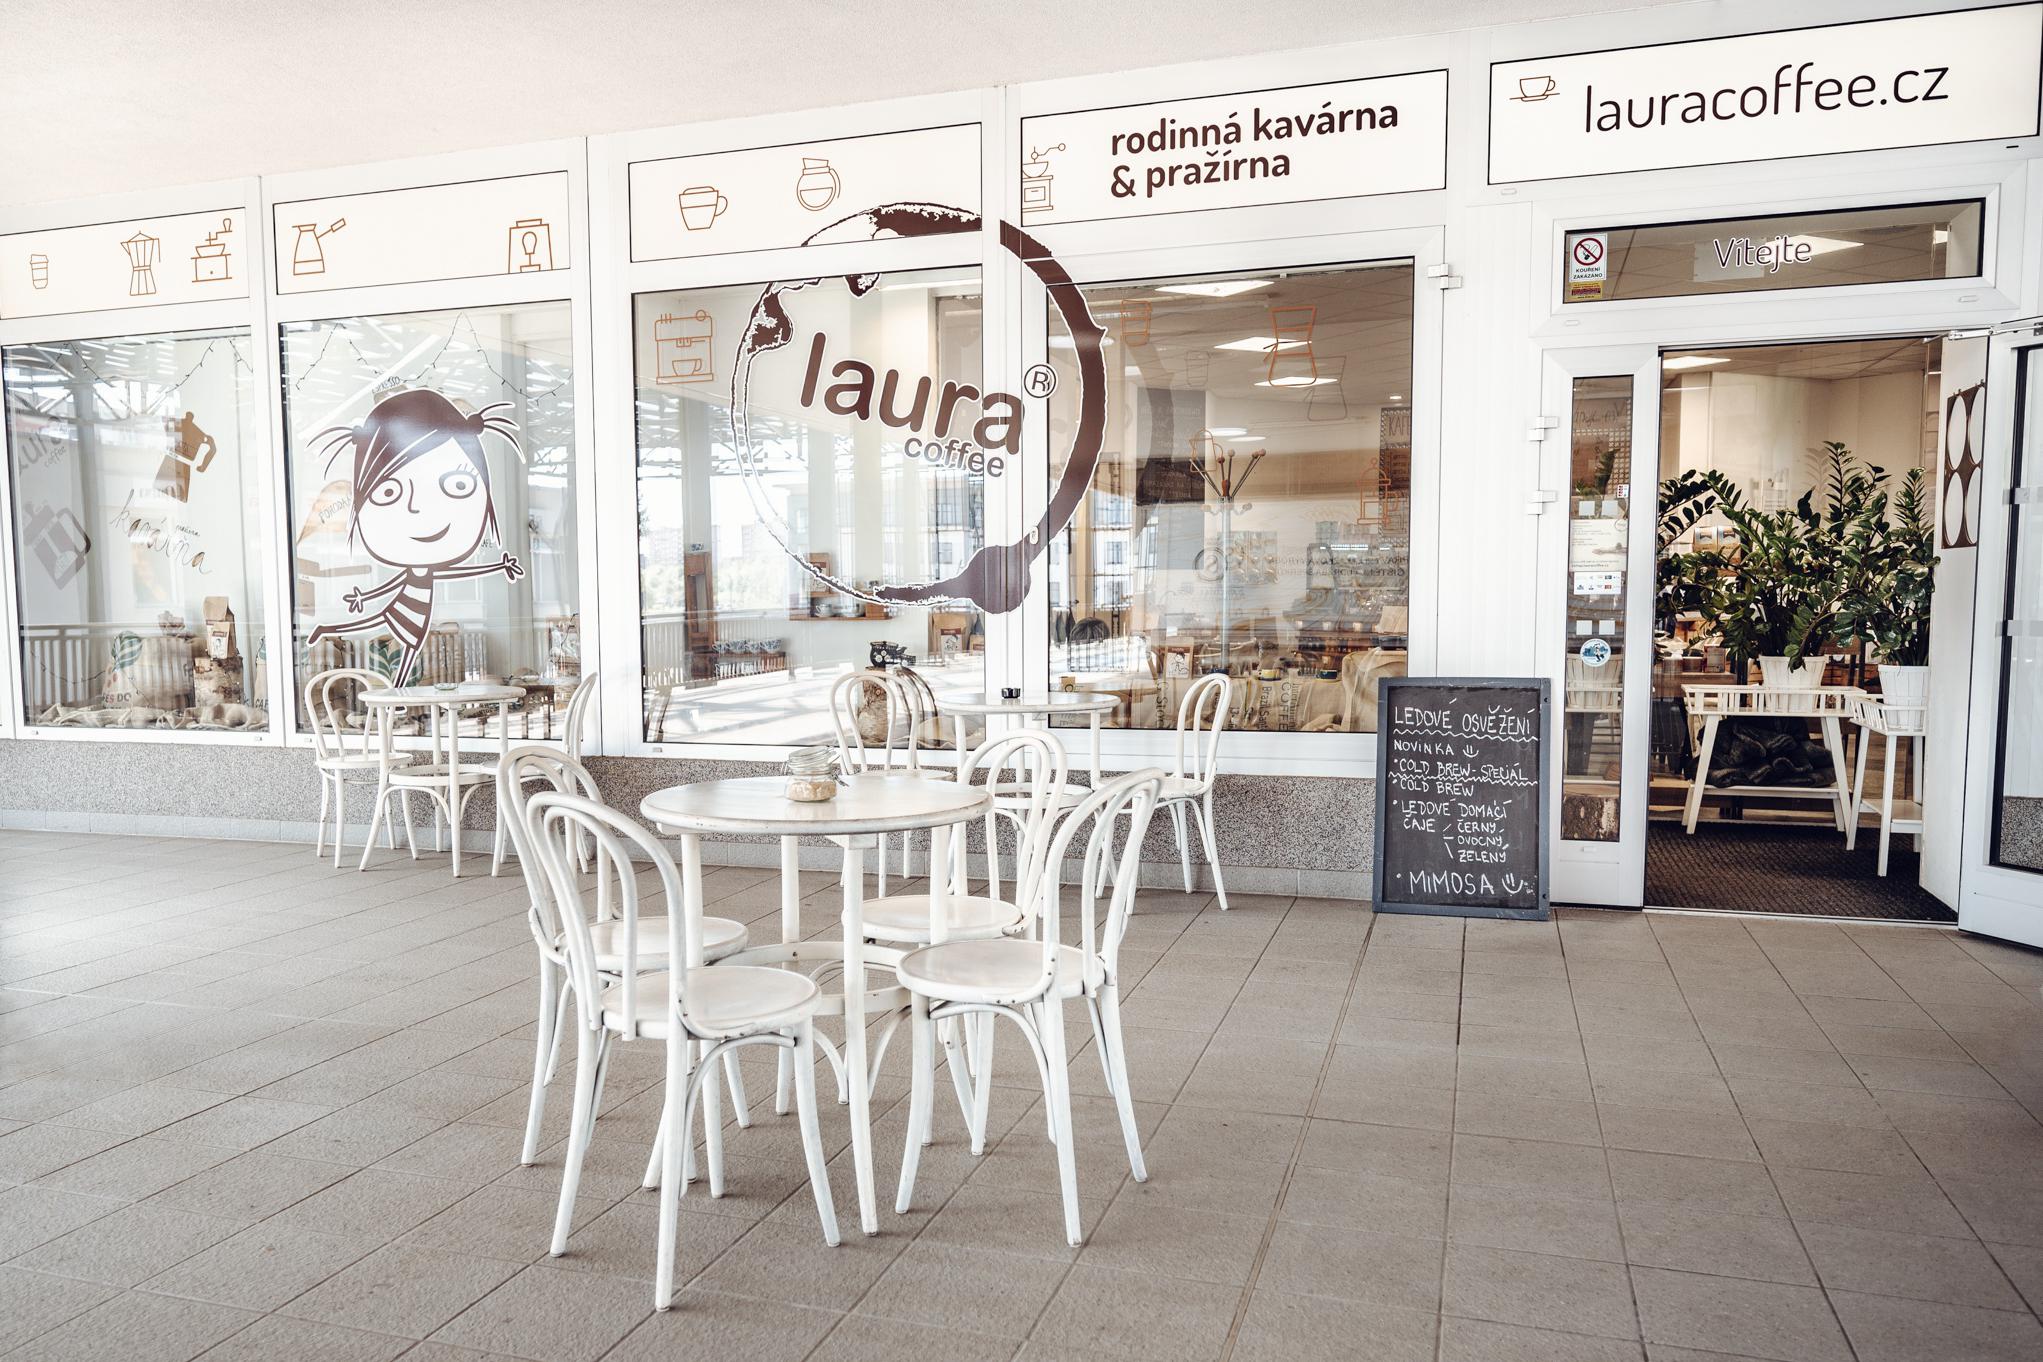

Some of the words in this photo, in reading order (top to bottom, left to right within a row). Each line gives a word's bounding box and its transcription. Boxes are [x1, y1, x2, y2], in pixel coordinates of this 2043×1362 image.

[1585, 62, 1950, 133] lauracoffee.cz
[1111, 112, 1242, 156] rodinná
[1253, 101, 1399, 141] kavárna
[1110, 164, 1137, 198] &
[1146, 149, 1291, 198] pražírna
[1713, 236, 1812, 273] Vítejte
[800, 332, 1025, 455] laura
[904, 437, 1005, 477] coffee
[1394, 698, 1457, 729] LEDOVÉ
[1462, 704, 1536, 735] OSVĚŽENÍ
[1393, 739, 1455, 756] NOVINKA
[1399, 758, 1431, 774] COLD
[1399, 778, 1431, 793] COLD
[1437, 781, 1474, 797] BREW
[1457, 829, 1505, 847] OVOCNÝ
[1409, 870, 1495, 895] MIMOSA
